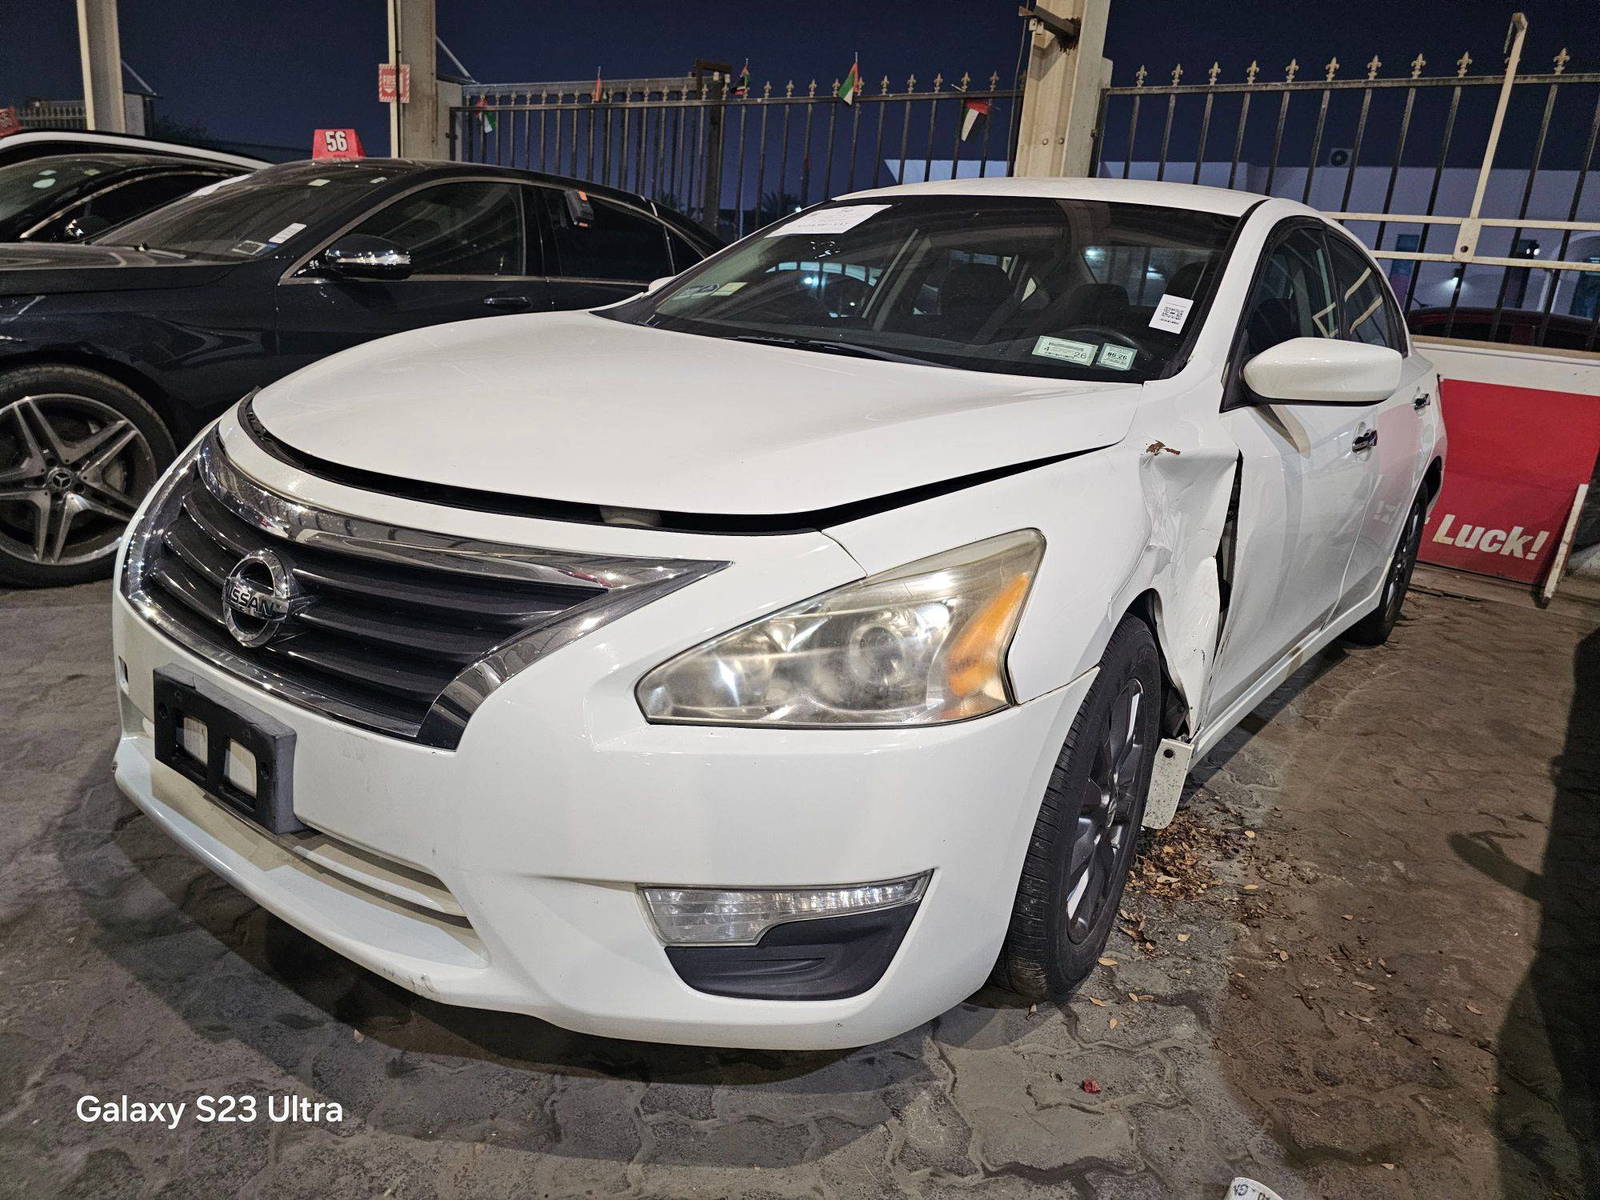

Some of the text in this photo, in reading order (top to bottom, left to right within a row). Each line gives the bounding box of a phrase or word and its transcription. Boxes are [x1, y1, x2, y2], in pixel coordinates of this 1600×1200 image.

[325, 131, 348, 152] 56
[1432, 513, 1550, 561] Luck!
[225, 585, 274, 616] ISSAN
